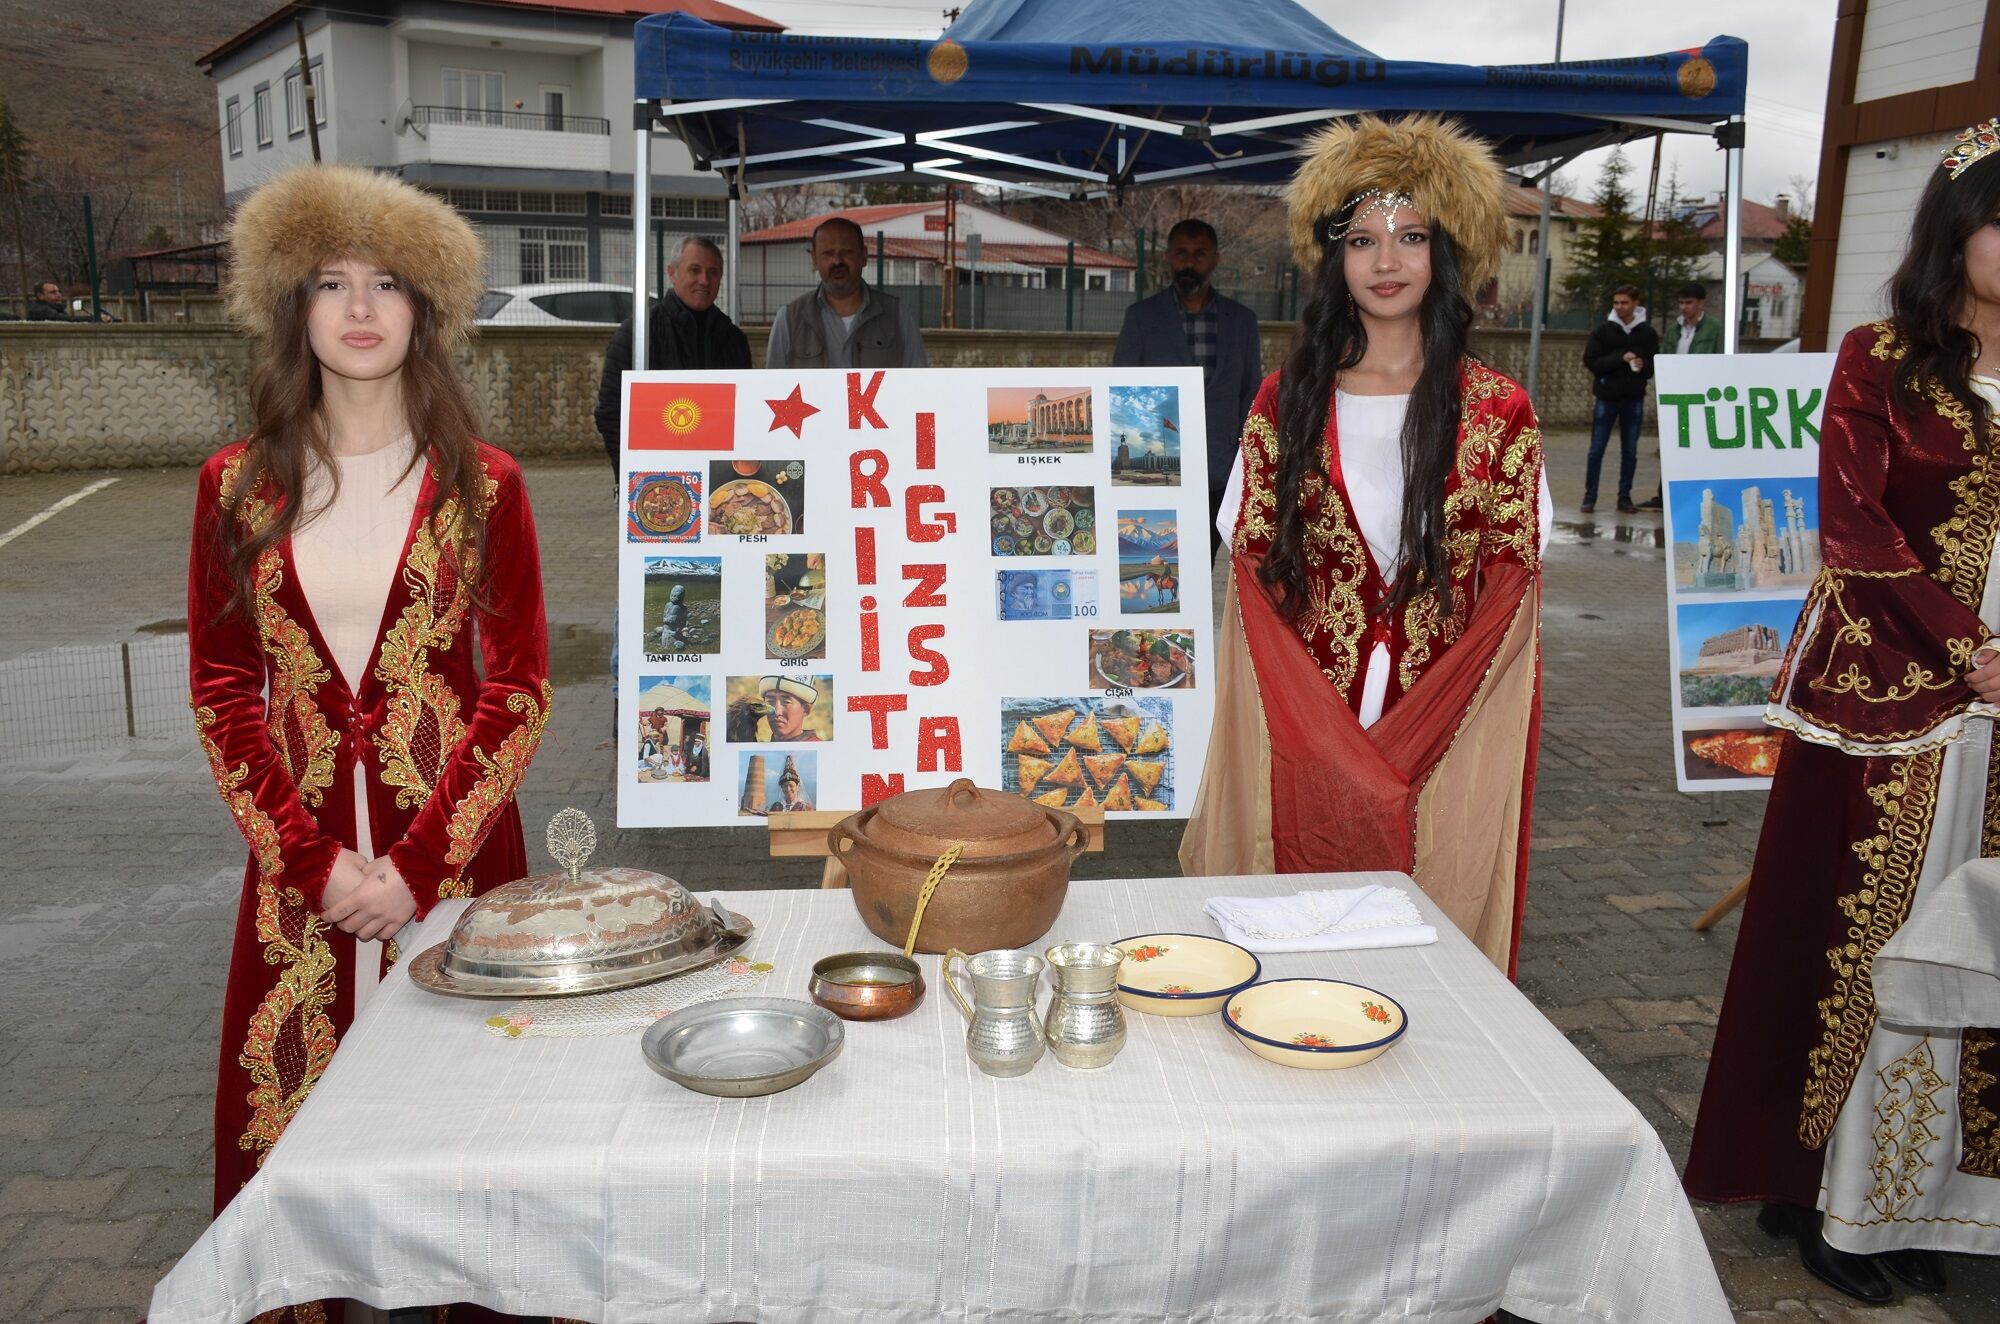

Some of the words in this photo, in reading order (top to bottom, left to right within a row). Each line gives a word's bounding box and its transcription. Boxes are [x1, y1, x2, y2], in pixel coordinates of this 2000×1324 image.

[729, 49, 826, 75] Büyükşehir
[832, 50, 920, 73] Belediyesi
[1069, 46, 1387, 88] Müdürlüğü
[681, 475, 698, 485] 150
[739, 534, 768, 543] PESH
[1074, 605, 1097, 617] 100
